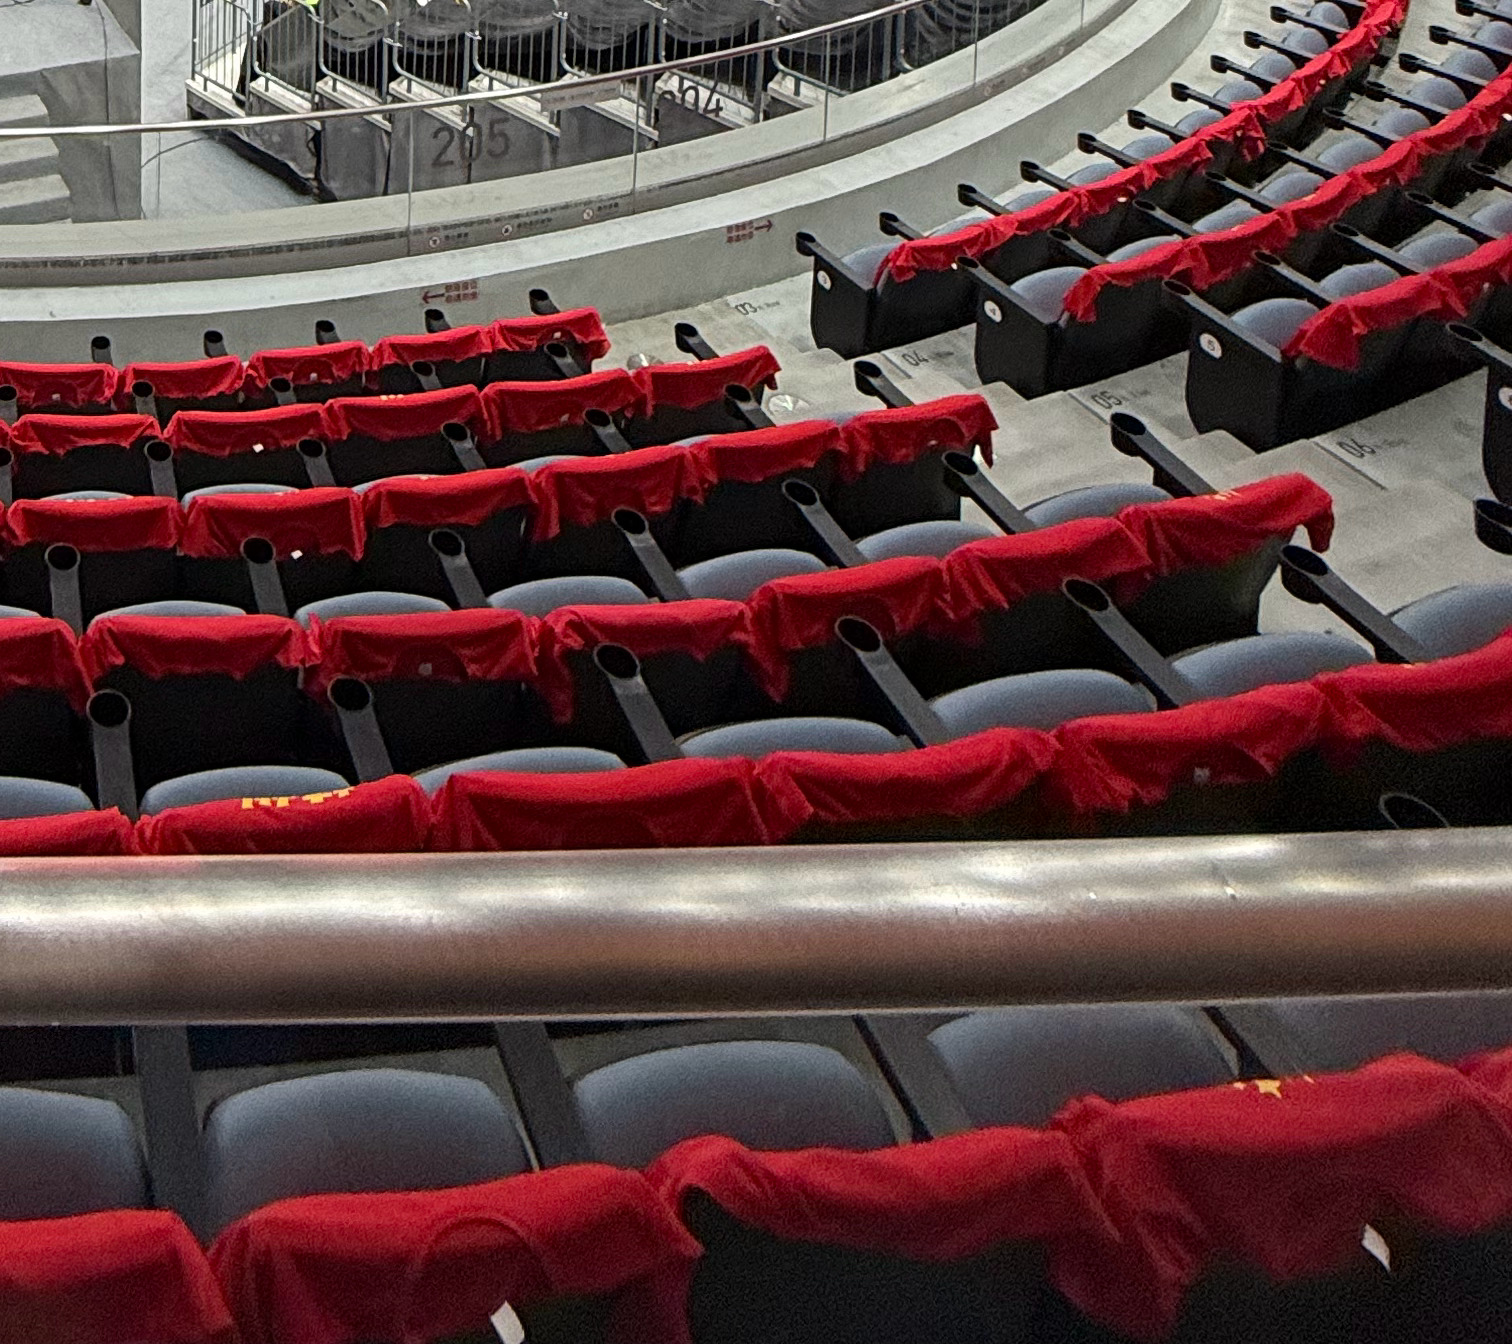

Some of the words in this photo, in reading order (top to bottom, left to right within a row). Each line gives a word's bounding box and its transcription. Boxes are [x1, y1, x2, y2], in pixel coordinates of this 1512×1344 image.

[432, 117, 511, 166] 205
[901, 349, 928, 367] 04
[1091, 390, 1123, 410] 05
[1337, 438, 1377, 459] 06
